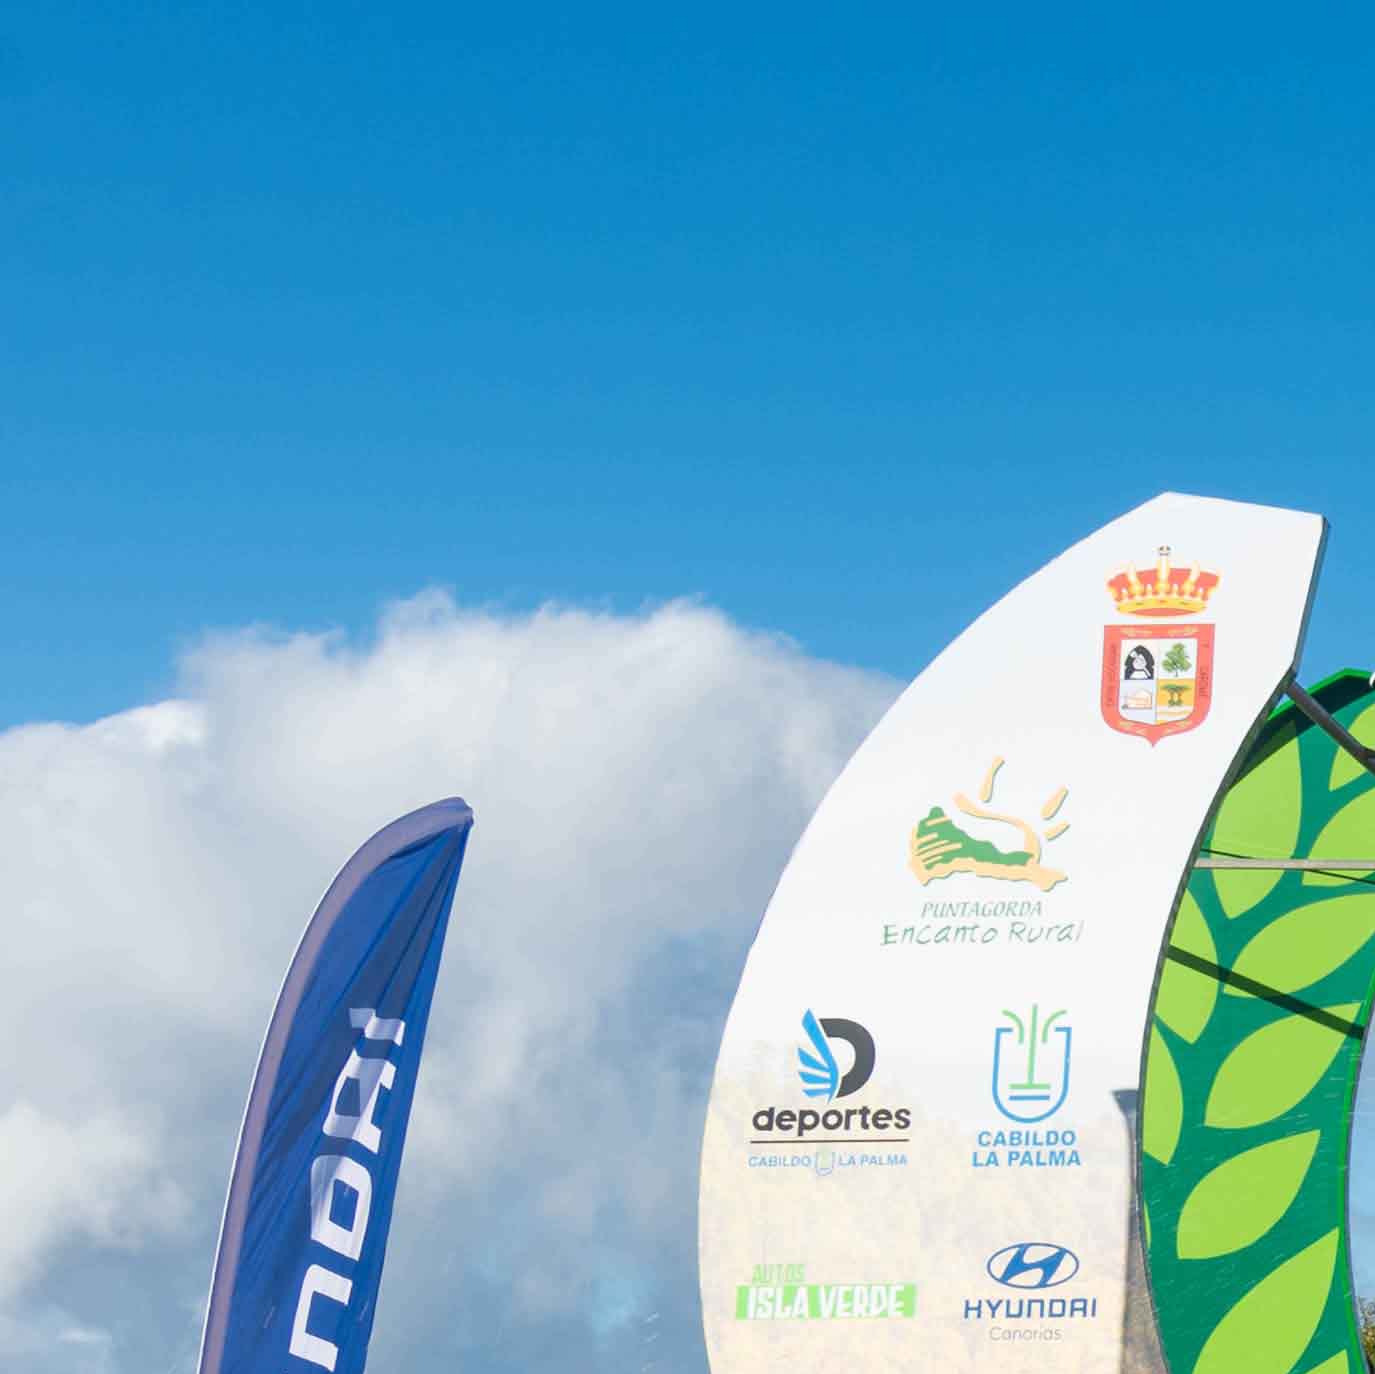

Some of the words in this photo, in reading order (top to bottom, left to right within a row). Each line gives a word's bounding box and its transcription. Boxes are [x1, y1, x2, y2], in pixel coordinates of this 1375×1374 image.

[921, 900, 1043, 920] PUNTAGORDA
[880, 922, 998, 946] Encanto
[1009, 919, 1083, 944] Rural
[752, 1104, 912, 1137] deportes
[977, 1130, 1077, 1147] CABILDO
[748, 1155, 812, 1169] CABILDO
[837, 1154, 856, 1168] LA
[859, 1153, 908, 1168] PALMA
[972, 1152, 1001, 1168] LA
[1007, 1150, 1081, 1168] PALMA
[747, 1285, 809, 1320] ISLA
[817, 1283, 905, 1318] VERDE
[963, 1298, 1097, 1320] HYUNDAI
[989, 1326, 1062, 1342] Canarias
